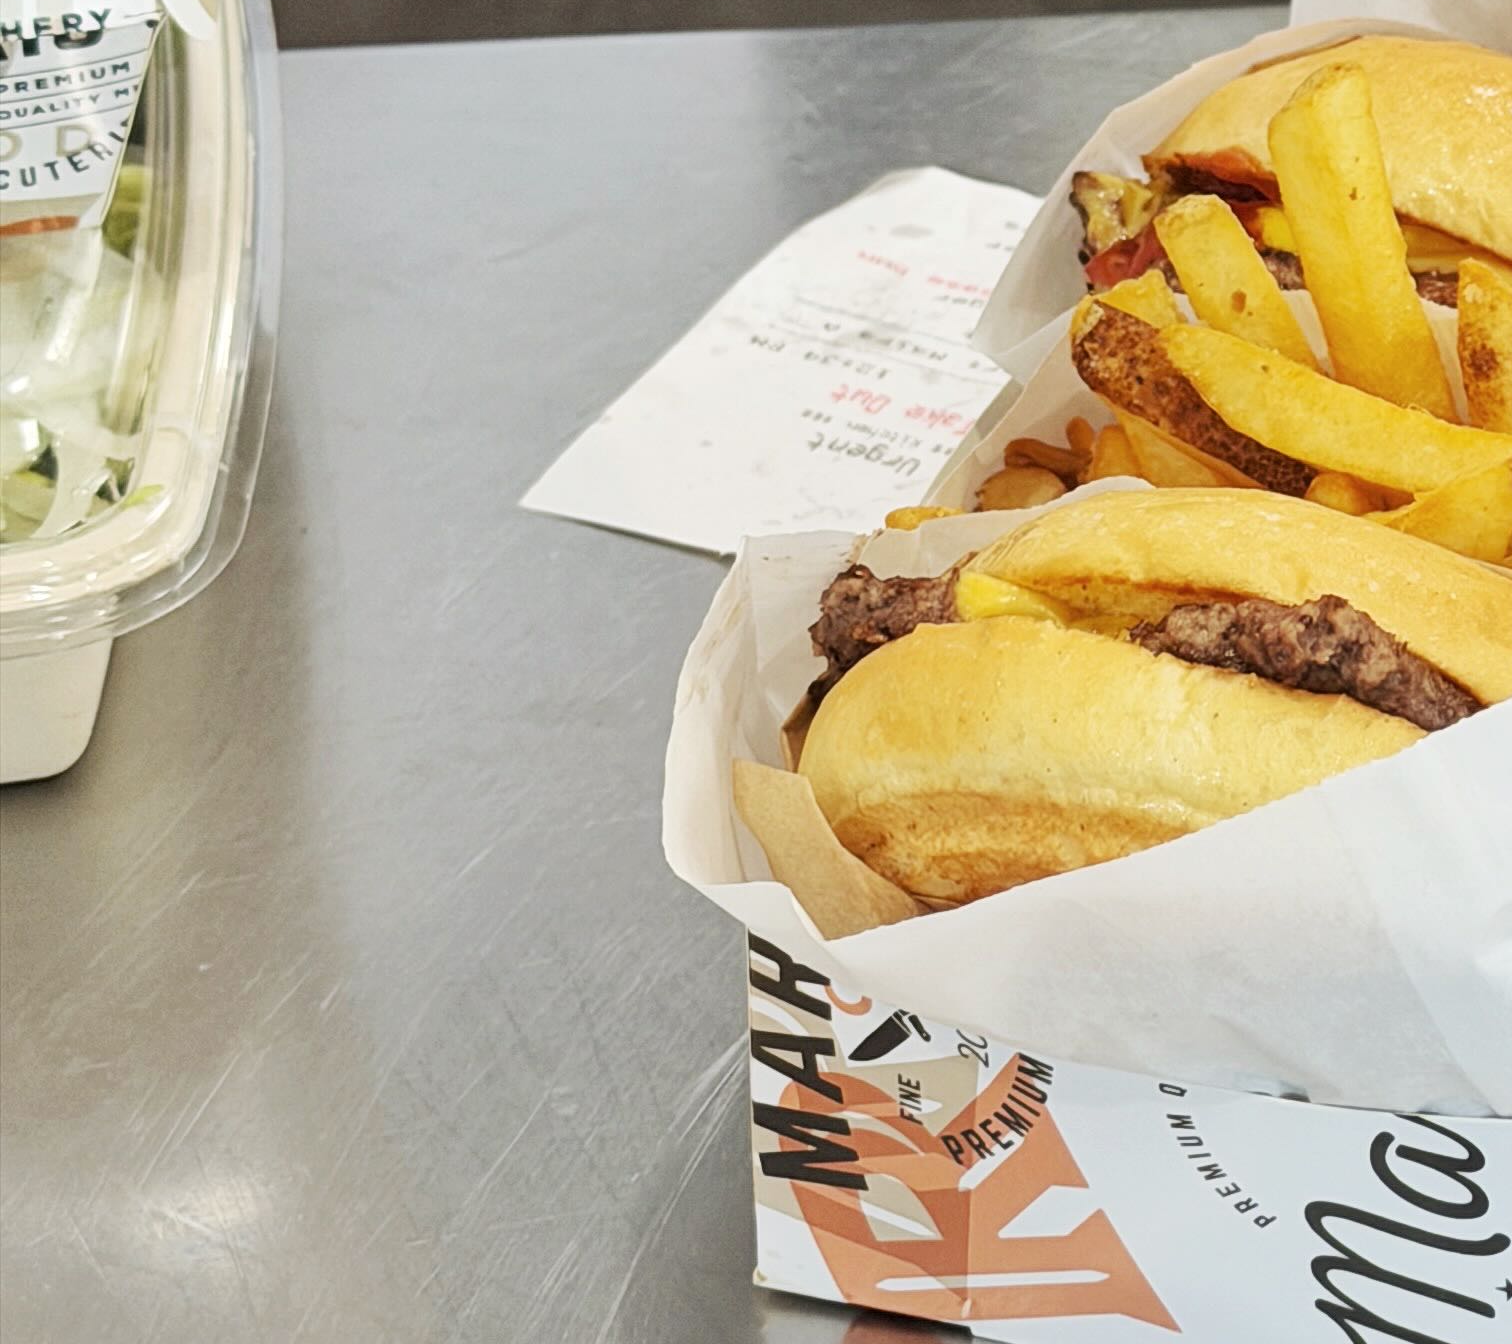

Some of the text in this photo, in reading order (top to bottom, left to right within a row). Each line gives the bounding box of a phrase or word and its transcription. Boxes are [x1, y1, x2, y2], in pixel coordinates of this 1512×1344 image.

[830, 383, 892, 416] Out
[806, 432, 921, 478] Urgent
[897, 1072, 924, 1126] FINE
[940, 1051, 1055, 1166] PREMIUM
[1166, 1113, 1277, 1229] PREMIUM
